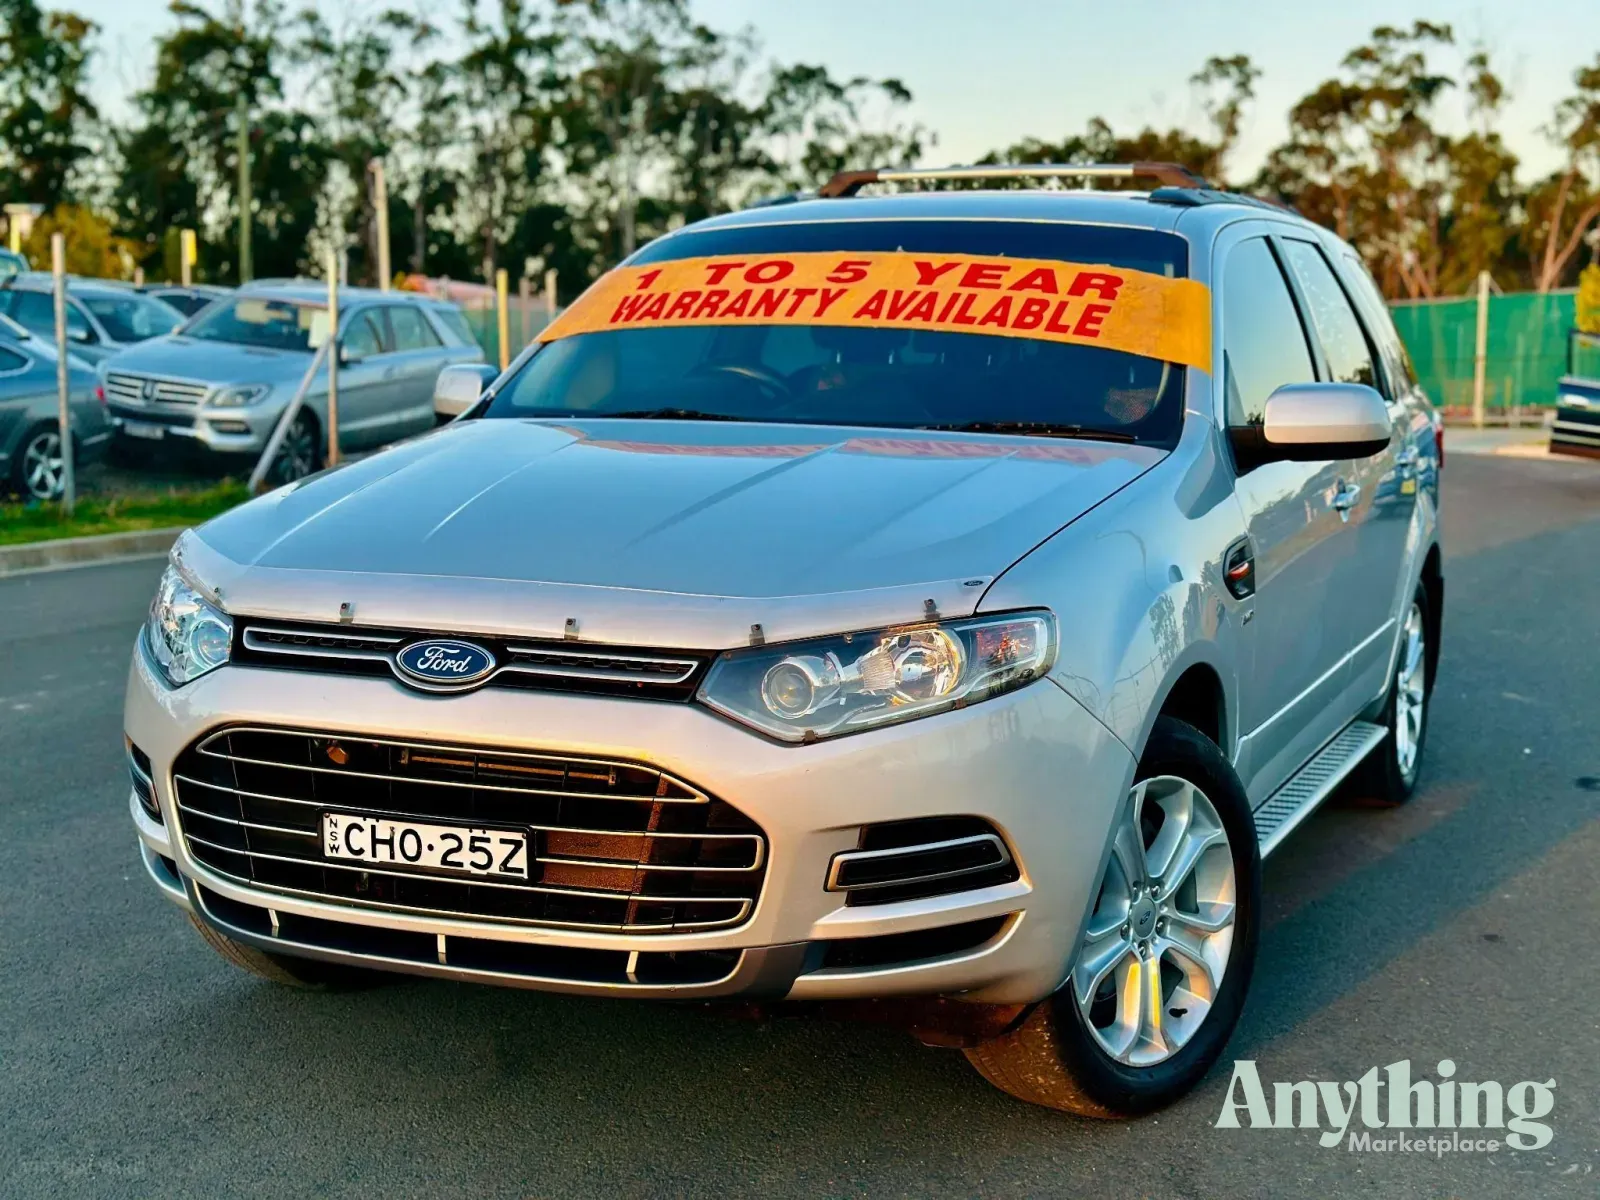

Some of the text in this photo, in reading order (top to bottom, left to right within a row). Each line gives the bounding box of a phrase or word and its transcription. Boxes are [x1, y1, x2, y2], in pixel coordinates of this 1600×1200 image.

[636, 260, 1124, 301] 1 TO 5 YEAR
[609, 288, 1112, 338] WARRANTY AVAILABLE
[416, 646, 473, 673] Ford
